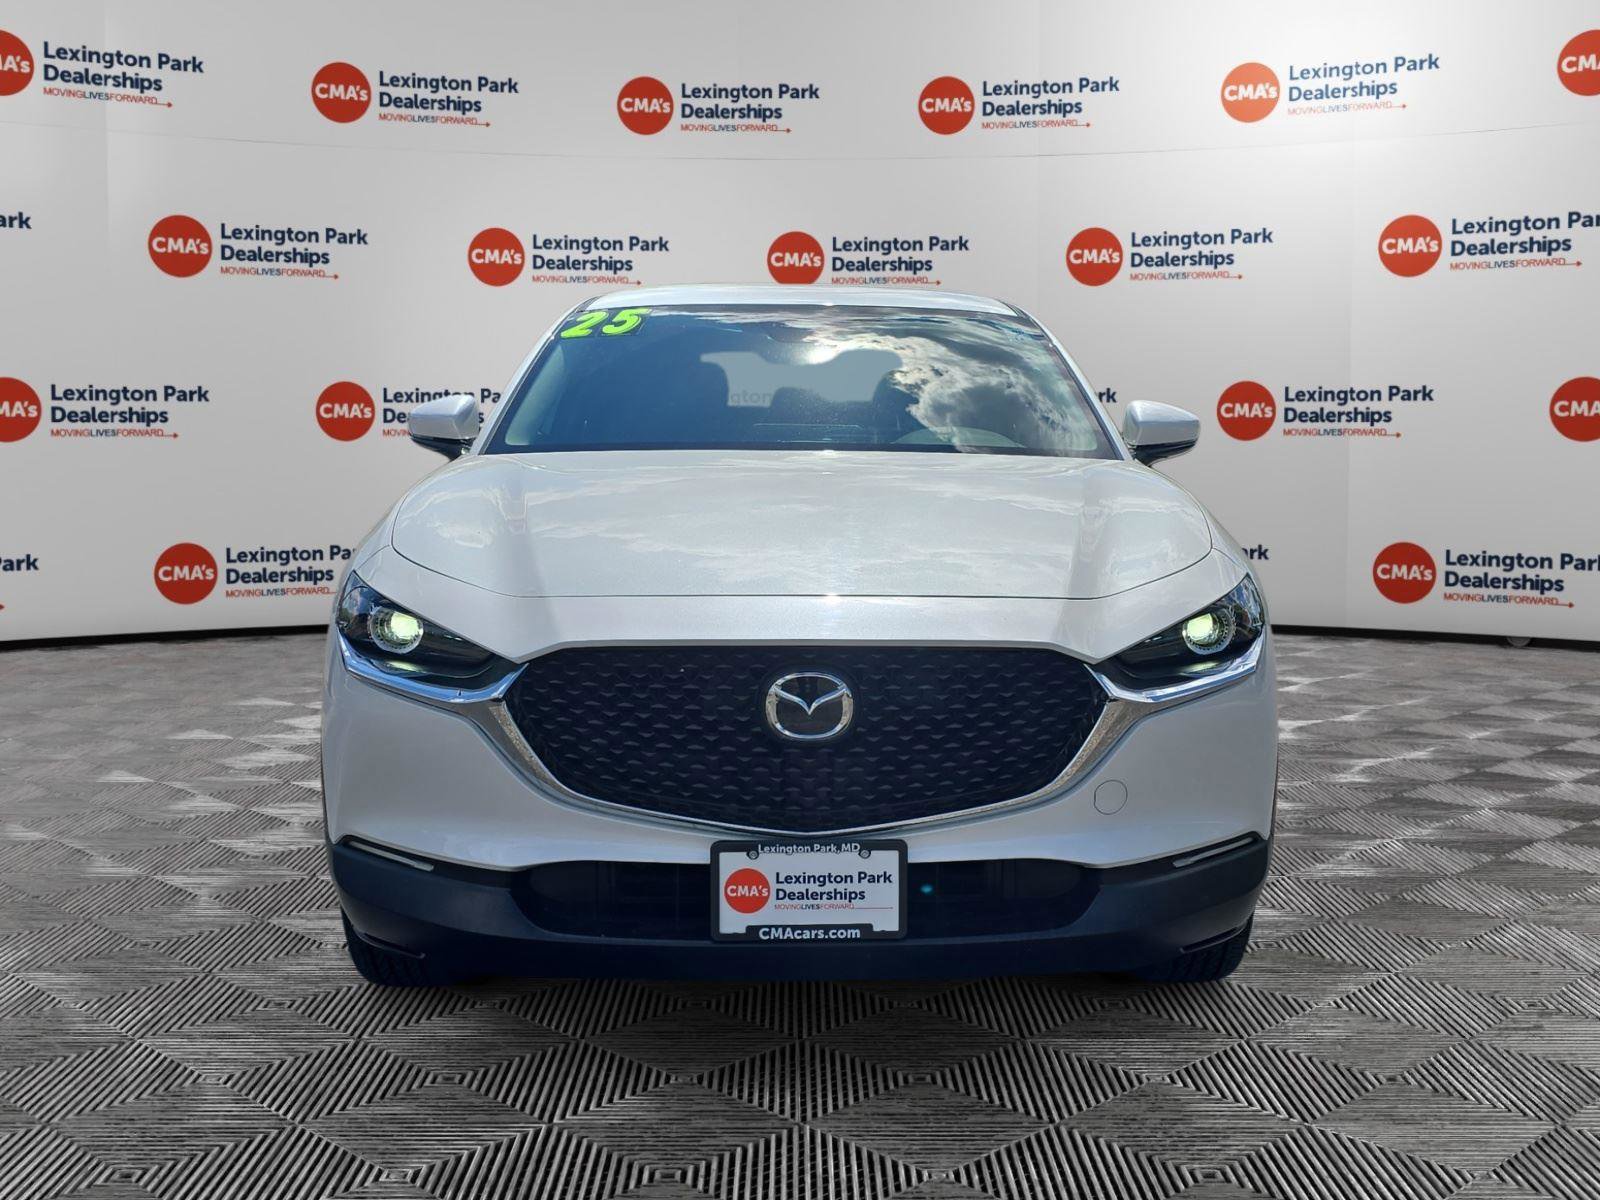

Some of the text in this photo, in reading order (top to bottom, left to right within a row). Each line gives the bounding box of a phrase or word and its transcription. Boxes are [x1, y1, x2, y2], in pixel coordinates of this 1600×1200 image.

[0, 55, 30, 73] A's
[44, 41, 204, 73] Lexington Park
[1289, 53, 1440, 81] Lexington Park
[43, 64, 163, 94] Dealerships
[379, 71, 519, 93] Lexington Park
[983, 77, 1120, 99] Lexington Park
[315, 83, 369, 101] CMA's
[681, 83, 820, 102] Lexington Park
[1223, 83, 1279, 101] CMA's
[1289, 80, 1398, 101] Dealerships
[379, 92, 482, 115] Dealerships
[620, 98, 671, 113] CMA's
[681, 103, 782, 122] Dealerships
[921, 97, 972, 113] CMA's
[982, 99, 1083, 118] Dealerships
[0, 211, 32, 229] ark
[1451, 211, 1600, 236] Lexington Par
[220, 223, 368, 246] Lexington Park
[532, 234, 670, 254] Lexington Park
[1131, 228, 1274, 250] Lexington Park
[152, 237, 209, 255] CMA's
[832, 235, 969, 255] Lexington Park
[1381, 236, 1439, 255] CMA's
[1450, 236, 1572, 257] Dealerships
[220, 245, 330, 268] Dealerships
[471, 248, 522, 264] CMA's
[532, 255, 633, 275] Dealerships
[770, 252, 822, 267] CMA's
[1069, 248, 1121, 264] CMA's
[1131, 251, 1235, 269] Dealerships
[832, 257, 933, 275] Dealerships
[560, 307, 651, 338] 25
[51, 384, 210, 405] Lexington Park
[480, 388, 502, 403] Pa
[1098, 387, 1117, 403] rk
[1284, 385, 1434, 405] Lexington Park
[0, 400, 38, 417] MA's
[51, 406, 168, 427] Dealerships
[319, 403, 373, 419] CMA's
[1220, 403, 1273, 418] CMA's
[1283, 406, 1392, 426] Dealerships
[1554, 400, 1600, 417] CMA
[226, 545, 354, 565] Lexington Pa
[1242, 544, 1269, 560] rk
[1445, 549, 1600, 571] Lexington Par
[0, 554, 39, 571] ark
[158, 564, 215, 581] CMA's
[226, 566, 334, 585] Dealerships
[1376, 564, 1433, 581] CMA's
[1444, 571, 1564, 595] Dealerships
[758, 844, 812, 855] Lexington
[775, 871, 892, 886] Lexington Park
[727, 885, 769, 897] CMA's
[775, 888, 865, 902] Dealerships
[758, 927, 861, 940] CMAcars.com
